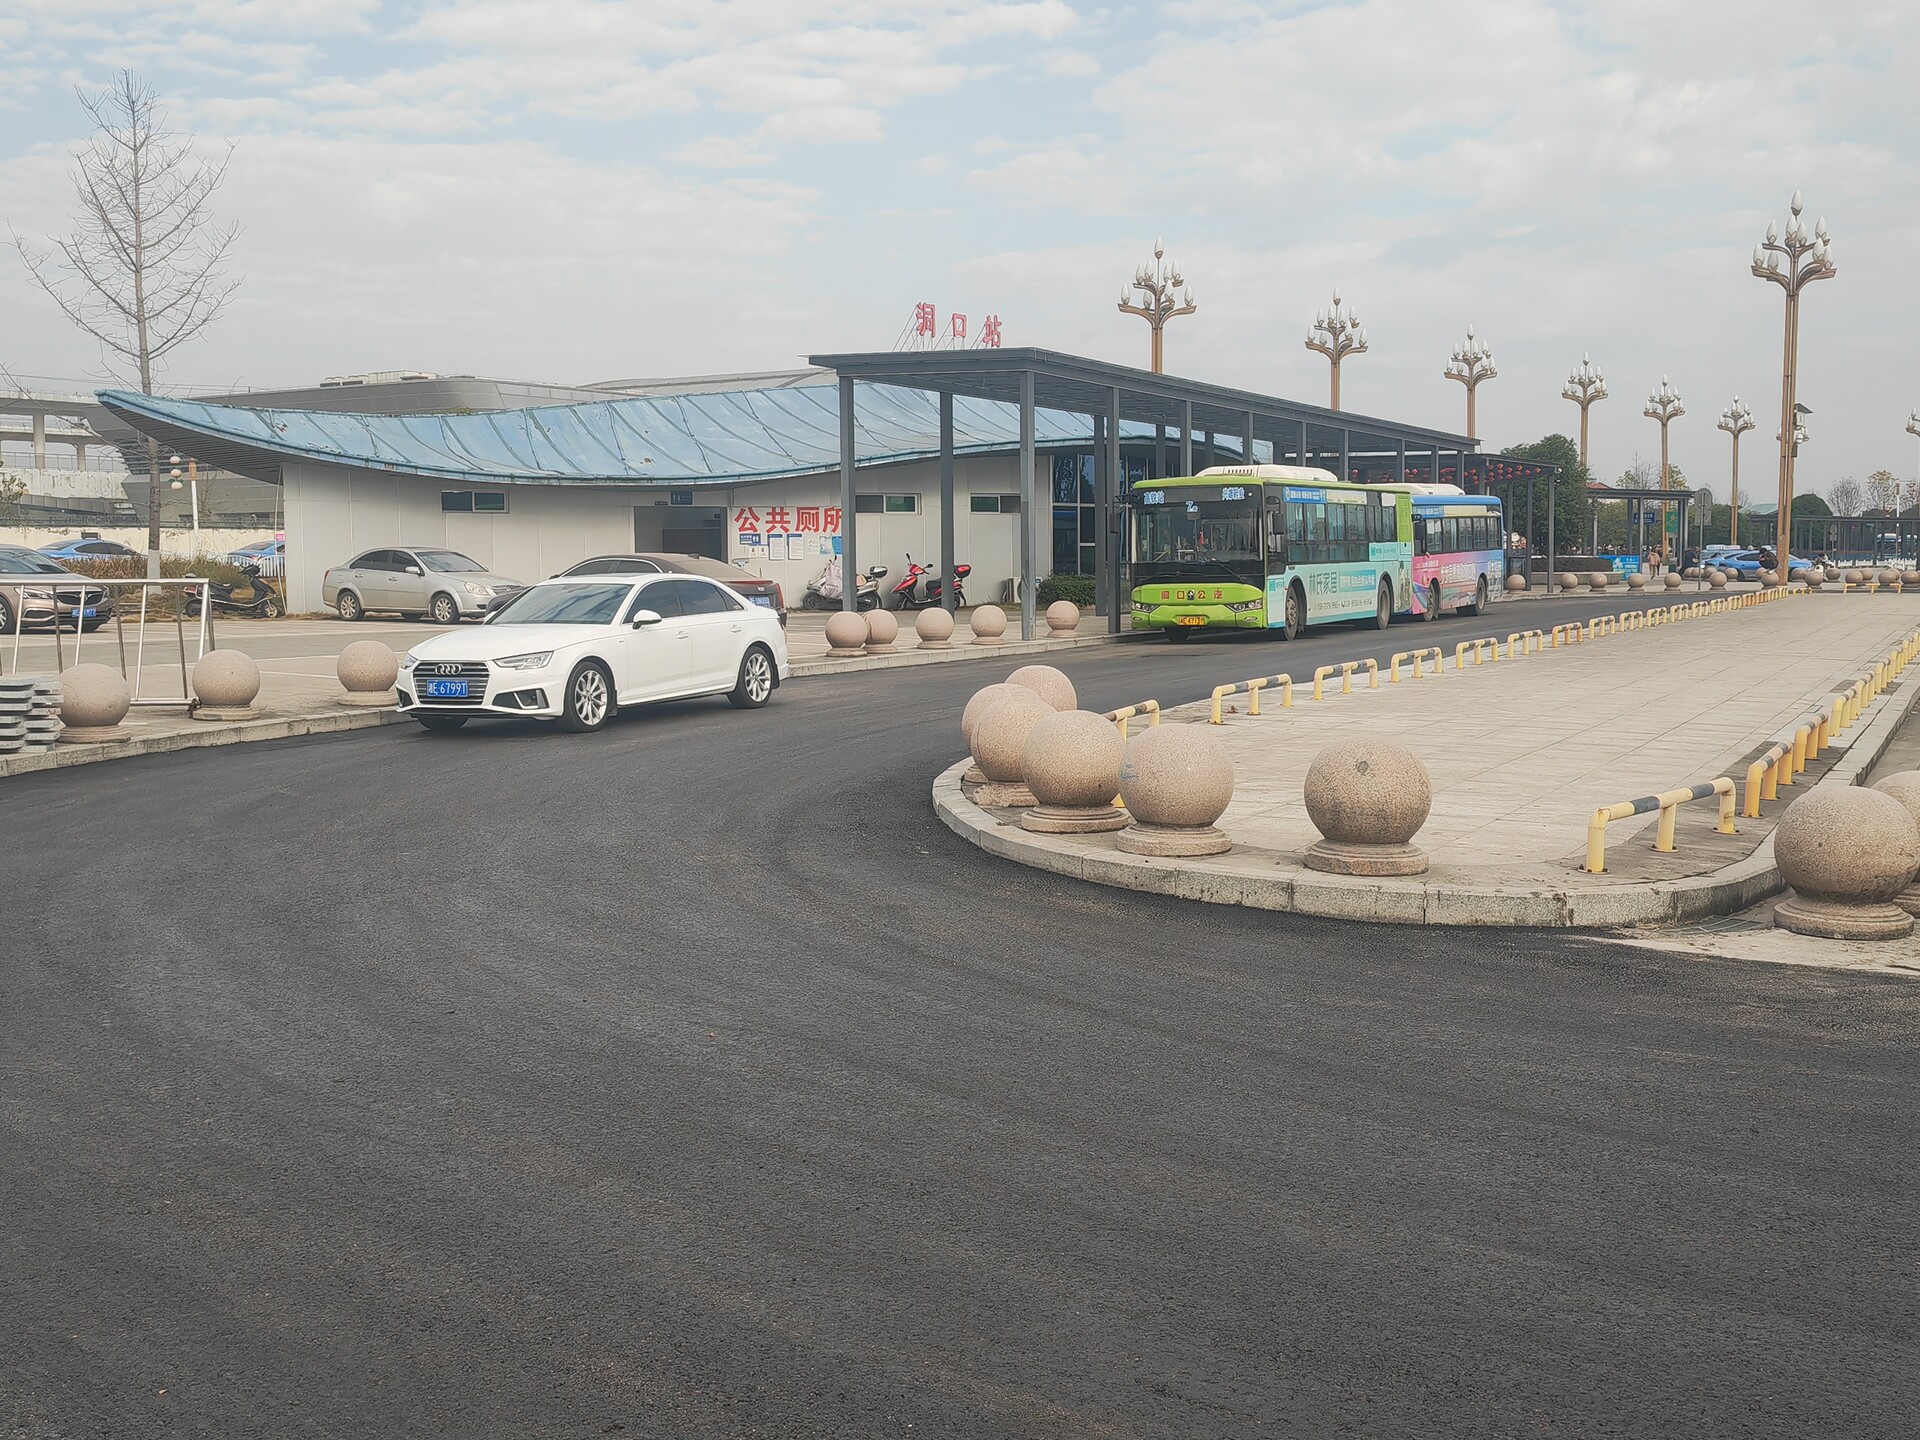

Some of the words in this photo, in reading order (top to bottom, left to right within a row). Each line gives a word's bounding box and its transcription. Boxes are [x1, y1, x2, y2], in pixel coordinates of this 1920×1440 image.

[915, 301, 1002, 347] 洞口站
[734, 506, 842, 533] 公共厕所
[1308, 571, 1338, 596] 林氏家居
